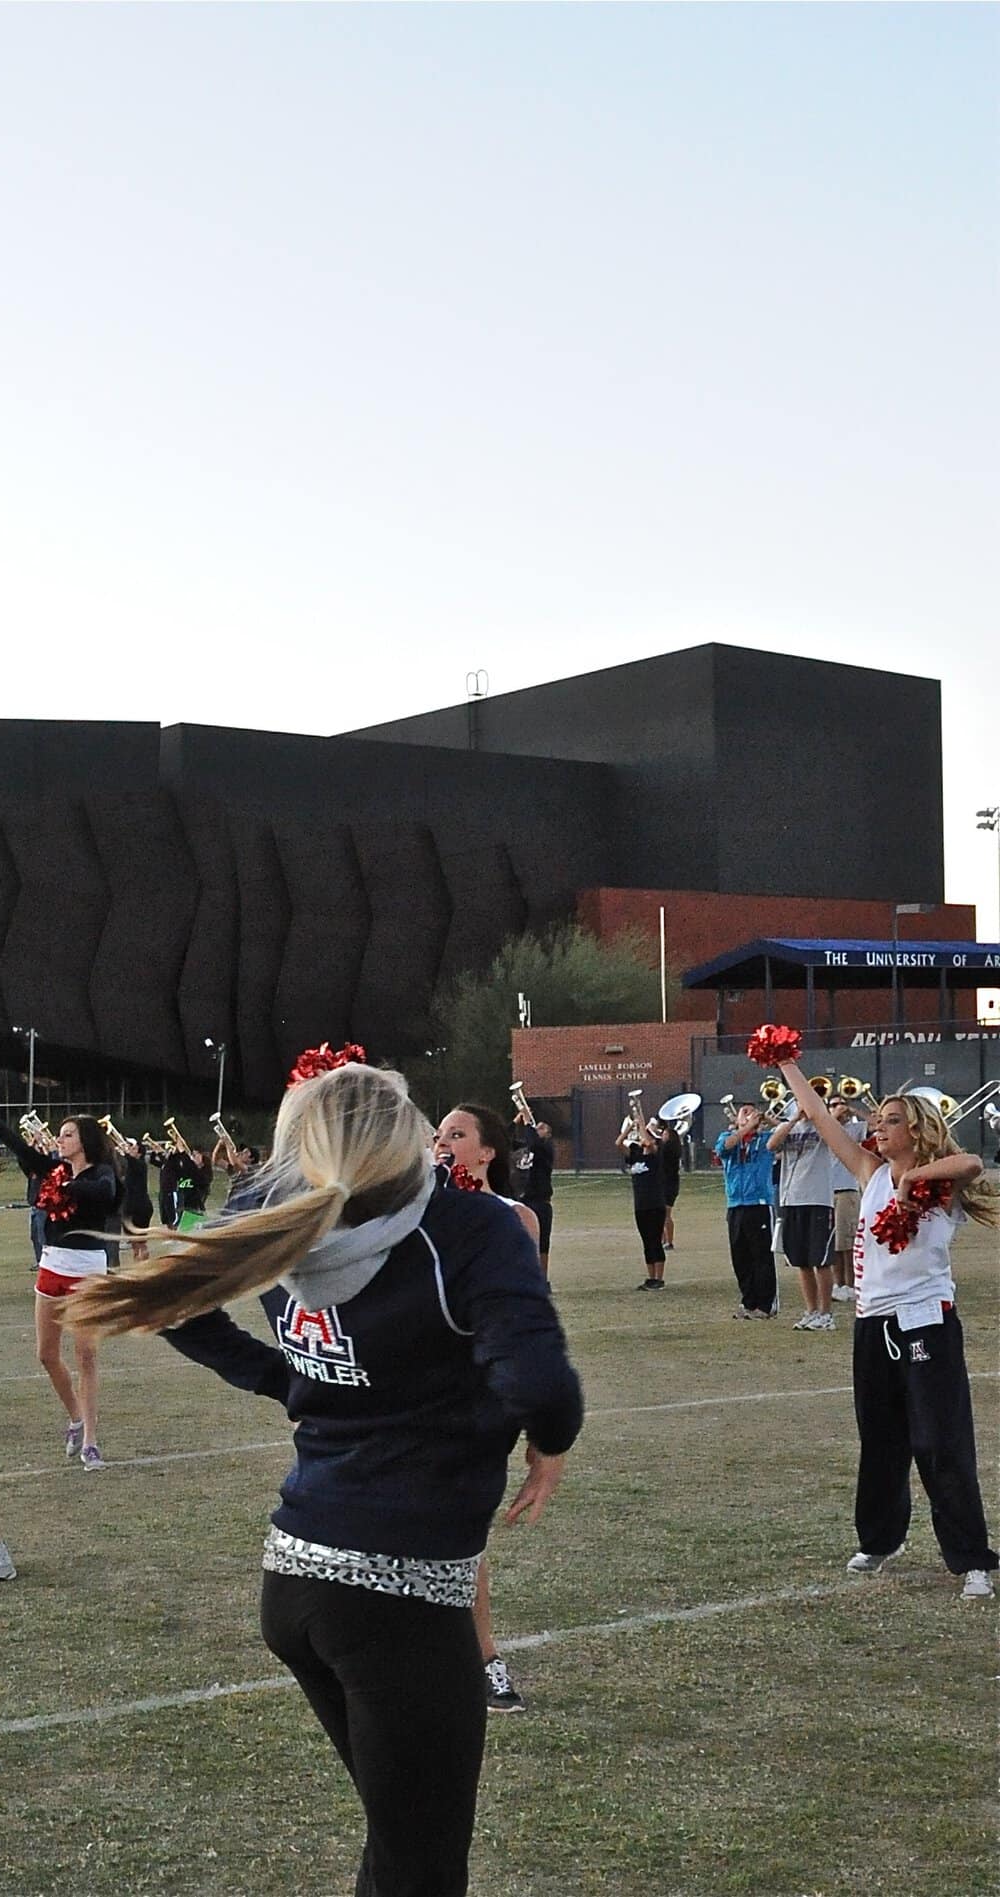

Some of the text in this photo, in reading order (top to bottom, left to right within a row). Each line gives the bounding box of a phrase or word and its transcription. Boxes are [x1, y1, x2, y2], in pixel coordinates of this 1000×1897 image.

[824, 951, 849, 965] THE
[866, 952, 936, 966] UNIVERSITY
[952, 955, 967, 967] OF
[616, 1072, 648, 1080] CENTER
[279, 1345, 371, 1387] TWIRLER
